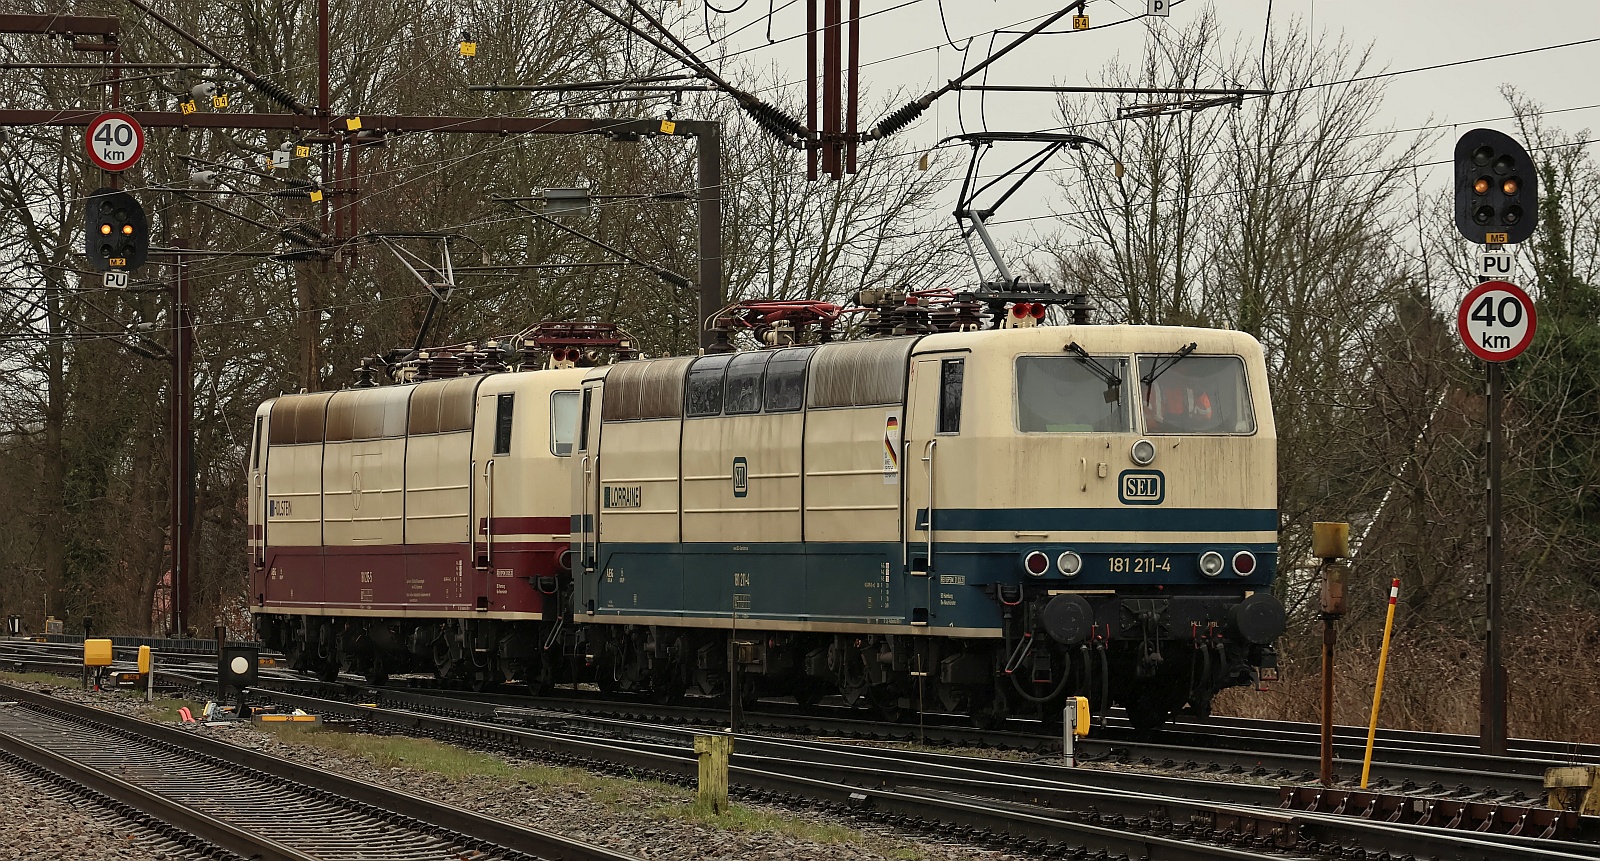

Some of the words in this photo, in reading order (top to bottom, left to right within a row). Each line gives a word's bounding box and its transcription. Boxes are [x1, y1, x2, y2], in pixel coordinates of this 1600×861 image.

[94, 123, 133, 147] 40
[103, 148, 125, 161] km
[1490, 234, 1505, 243] M5
[110, 258, 125, 266] M2
[1483, 256, 1511, 273] PU
[105, 273, 127, 287] PU
[1471, 296, 1523, 328] 40
[1482, 331, 1511, 349] km
[1127, 478, 1157, 496] SEL
[1108, 557, 1130, 573] 181
[1134, 557, 1171, 573] 211-4
